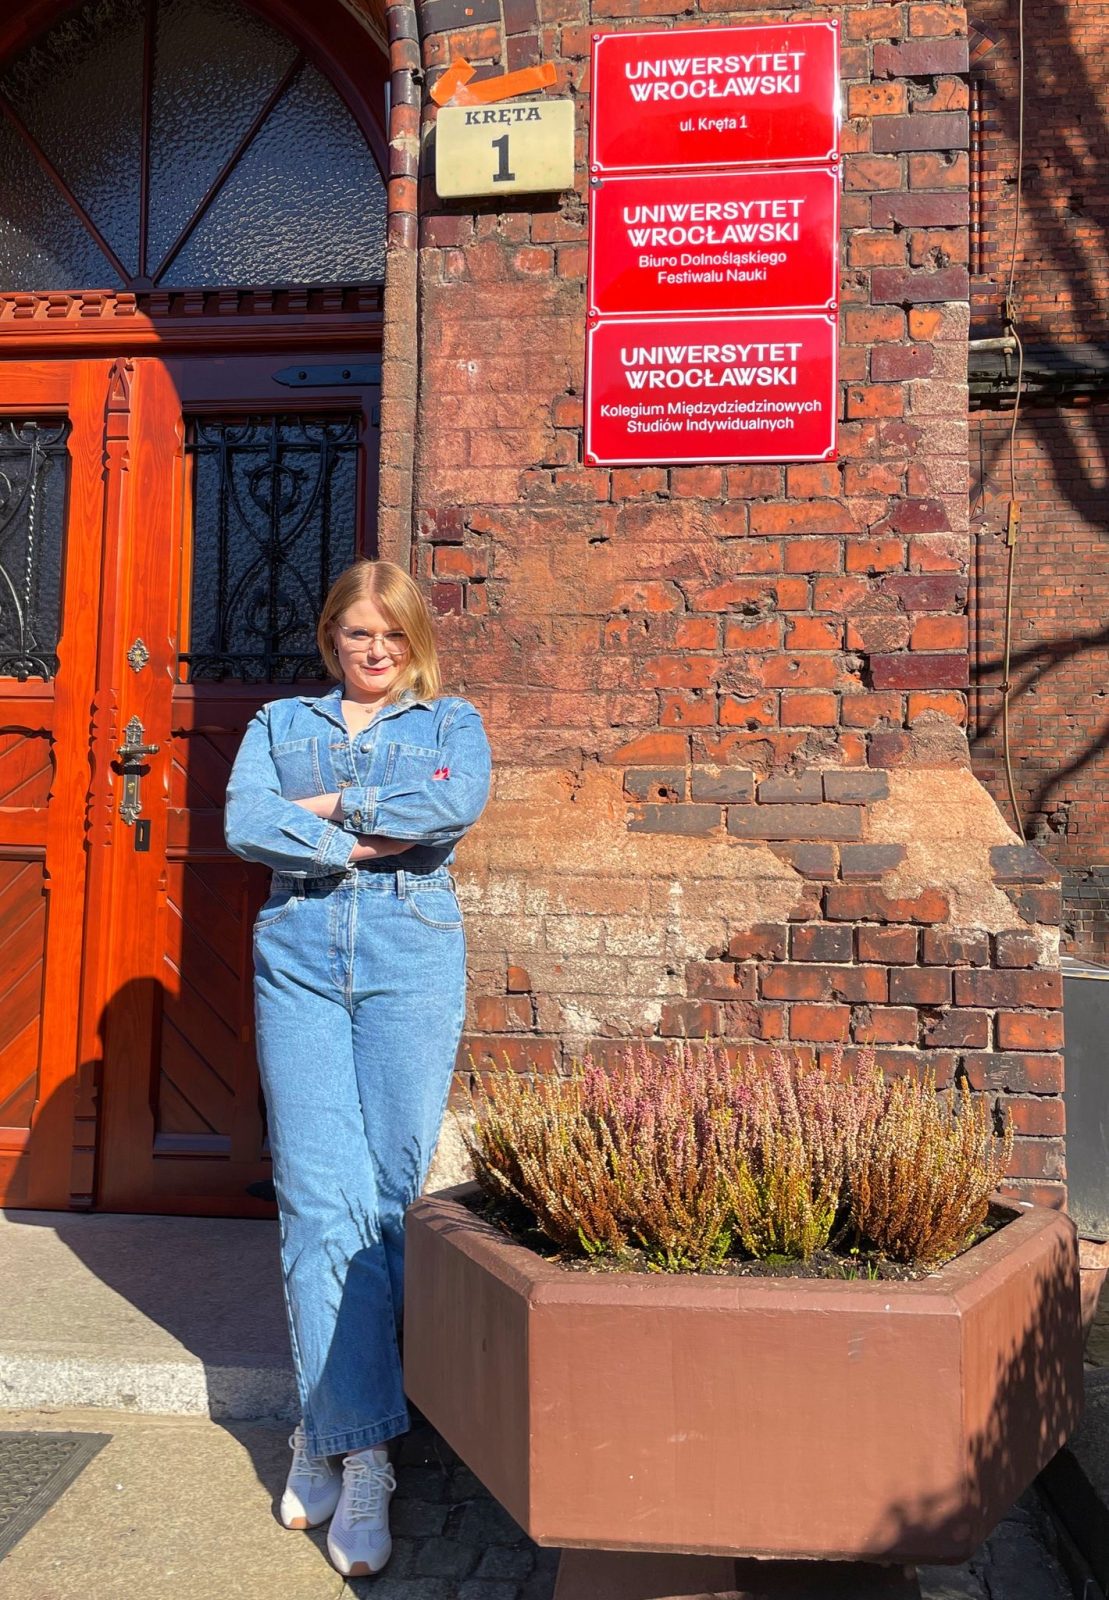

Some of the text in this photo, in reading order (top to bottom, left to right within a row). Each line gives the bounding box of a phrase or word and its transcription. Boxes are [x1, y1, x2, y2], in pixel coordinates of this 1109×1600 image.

[625, 52, 806, 79] UNIWERSYTET
[629, 75, 801, 102] WROCŁAWSKI
[465, 107, 542, 126] KRĘTA
[679, 115, 748, 133] ul. Kręta 1
[491, 134, 516, 182] 1
[623, 199, 805, 225] UNIWERSYTET
[627, 222, 799, 247] WROCŁAWSKI
[638, 250, 787, 268] Biuro Dolnośląskiego
[657, 267, 767, 284] Festiwalu Nauki
[620, 343, 803, 367] UNIWERSYTET
[625, 366, 797, 390] WROCŁAWSKI
[600, 399, 823, 419] Kolegium Międzydziedzinowych
[627, 417, 795, 433] Studiów Indywidualnych
